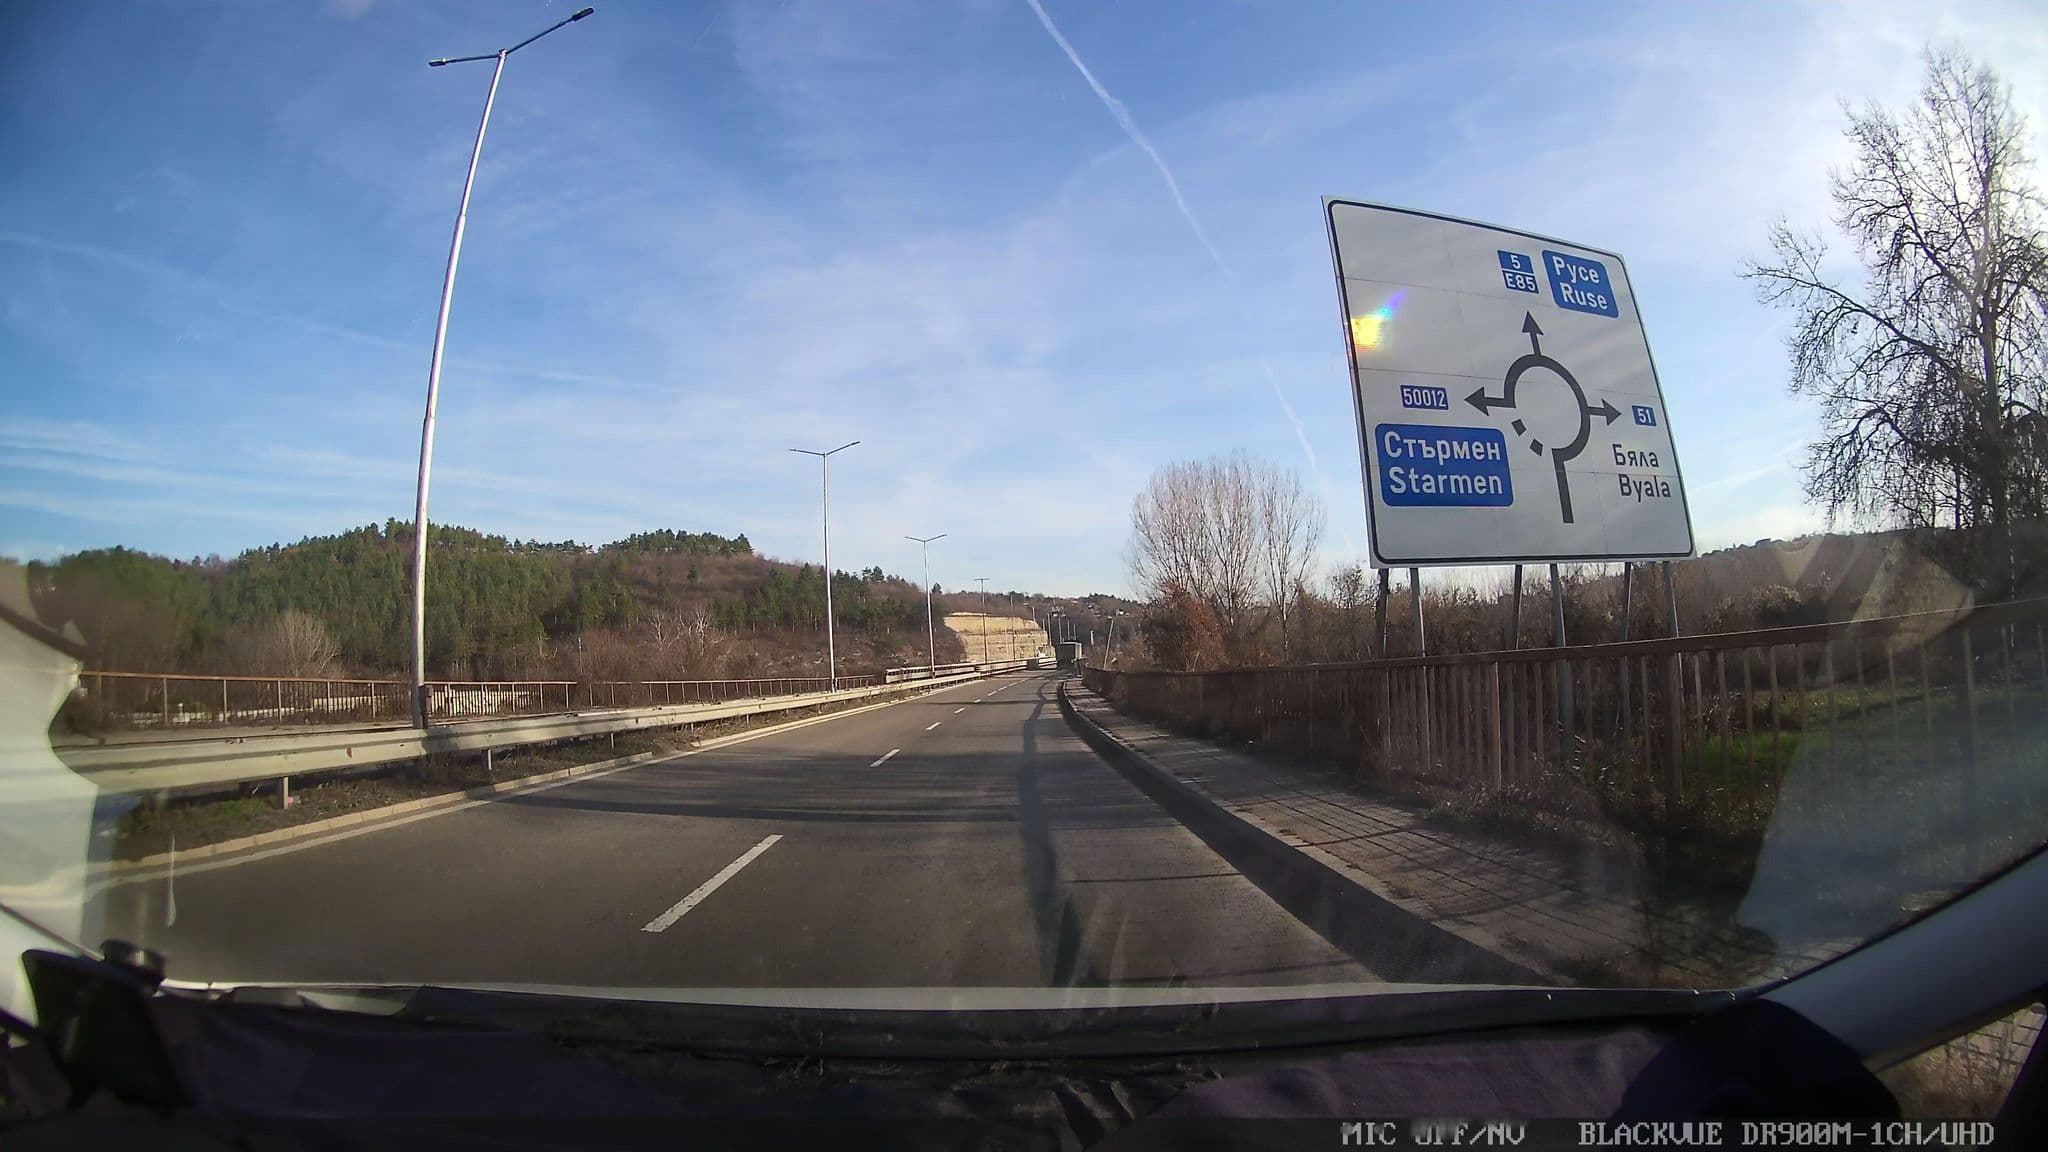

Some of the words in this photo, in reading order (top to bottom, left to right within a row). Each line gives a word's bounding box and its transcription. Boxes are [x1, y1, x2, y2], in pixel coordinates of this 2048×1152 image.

[1510, 255, 1520, 269] 5
[1552, 256, 1600, 284] Русе
[1505, 273, 1536, 291] E85
[1560, 282, 1608, 310] Ruse
[1403, 388, 1447, 407] 50012
[1637, 408, 1652, 424] 51
[1384, 431, 1501, 465] Стърмен
[1612, 443, 1659, 468] Бяла
[1388, 466, 1503, 495] Starmen
[1618, 473, 1671, 503] Byala
